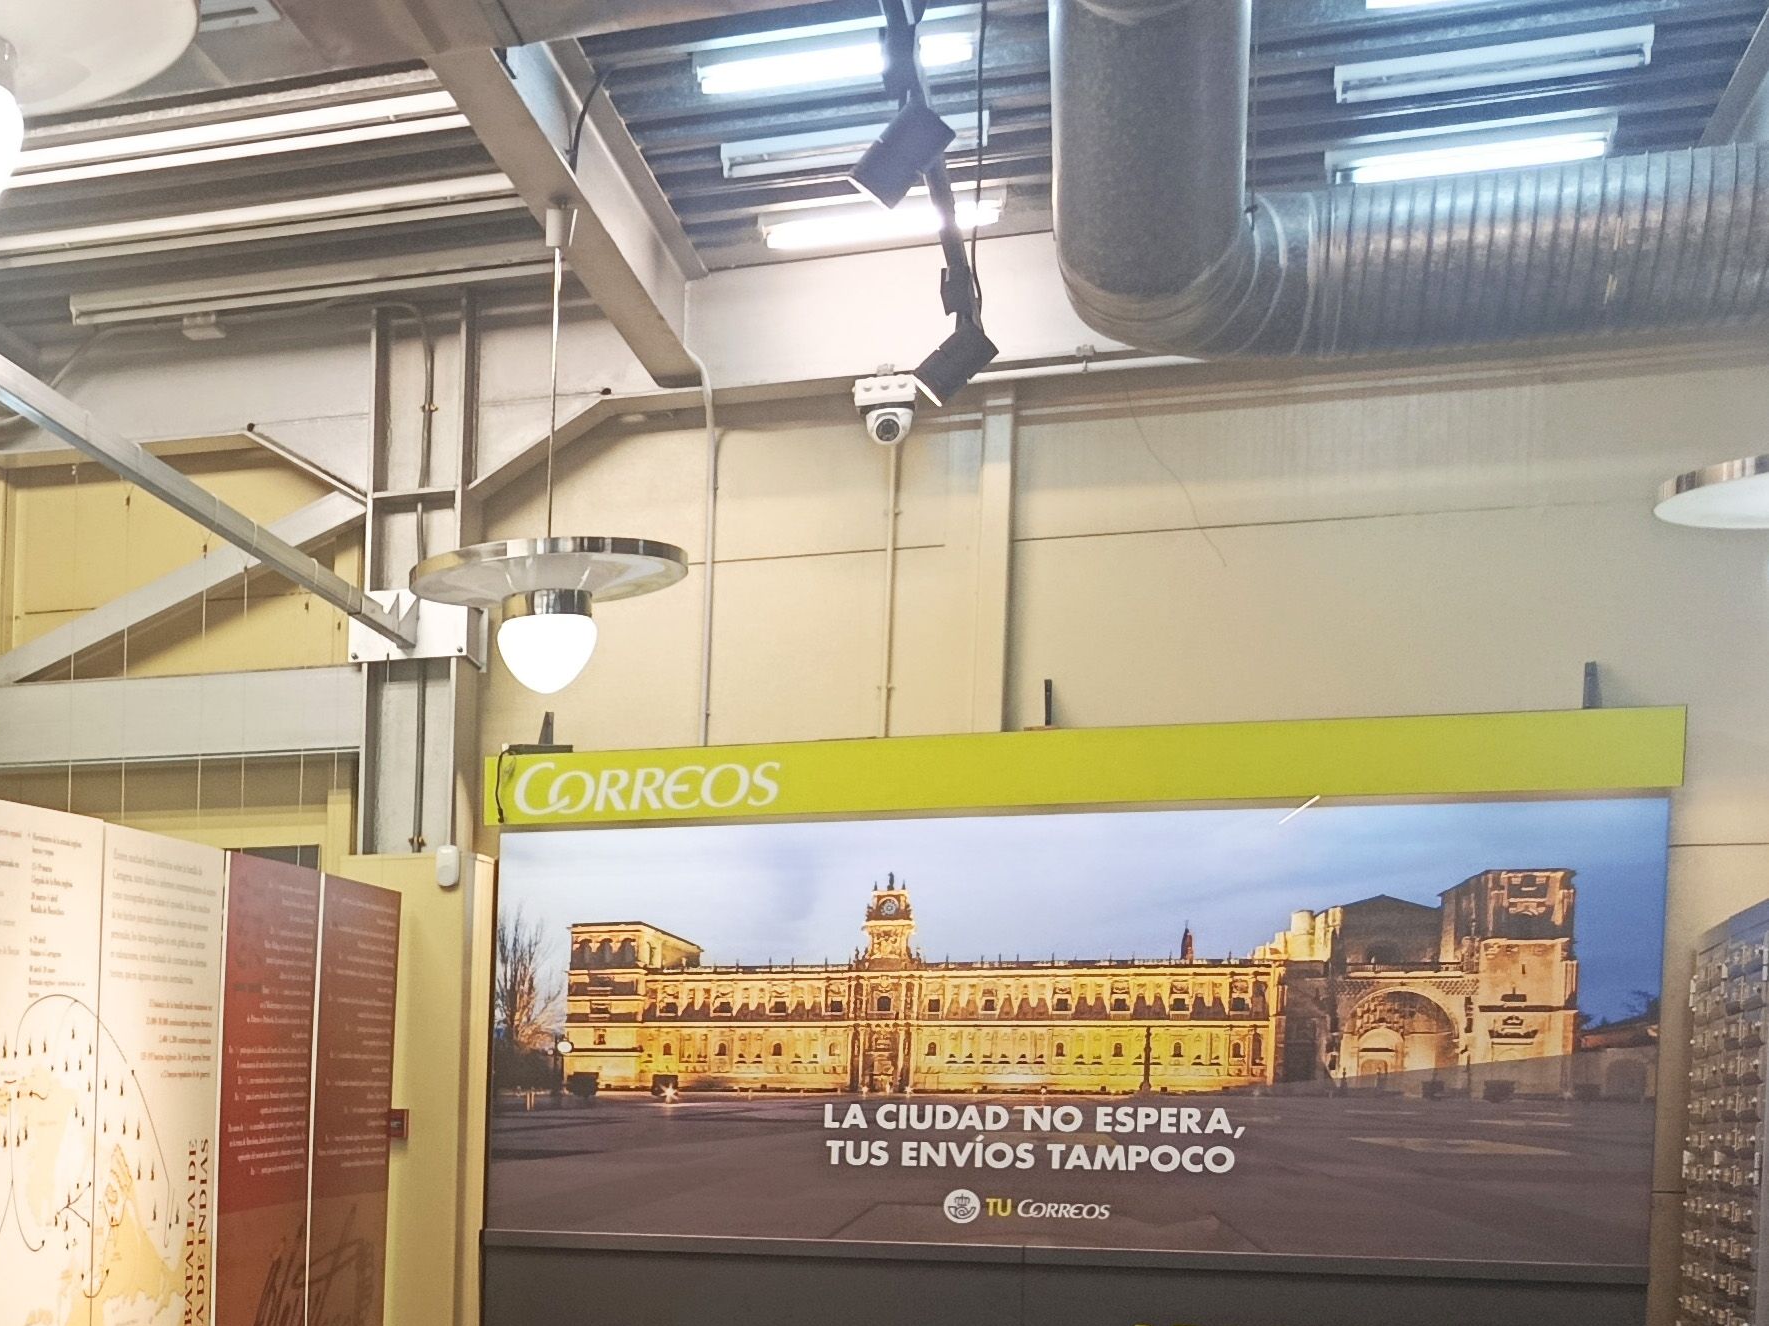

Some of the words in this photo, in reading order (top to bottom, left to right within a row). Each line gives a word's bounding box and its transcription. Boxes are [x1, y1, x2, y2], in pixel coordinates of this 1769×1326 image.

[823, 1103, 866, 1129] LA
[875, 1104, 1009, 1131] CIUDAD
[1024, 1107, 1083, 1133] NO
[1096, 1107, 1246, 1139] ESPERA,
[826, 1140, 890, 1166] TUS
[902, 1135, 1035, 1169] ENVÍOS
[1046, 1144, 1236, 1173] TAMPOCO
[198, 1138, 208, 1245] INDIAS
[985, 1198, 1011, 1217] TU
